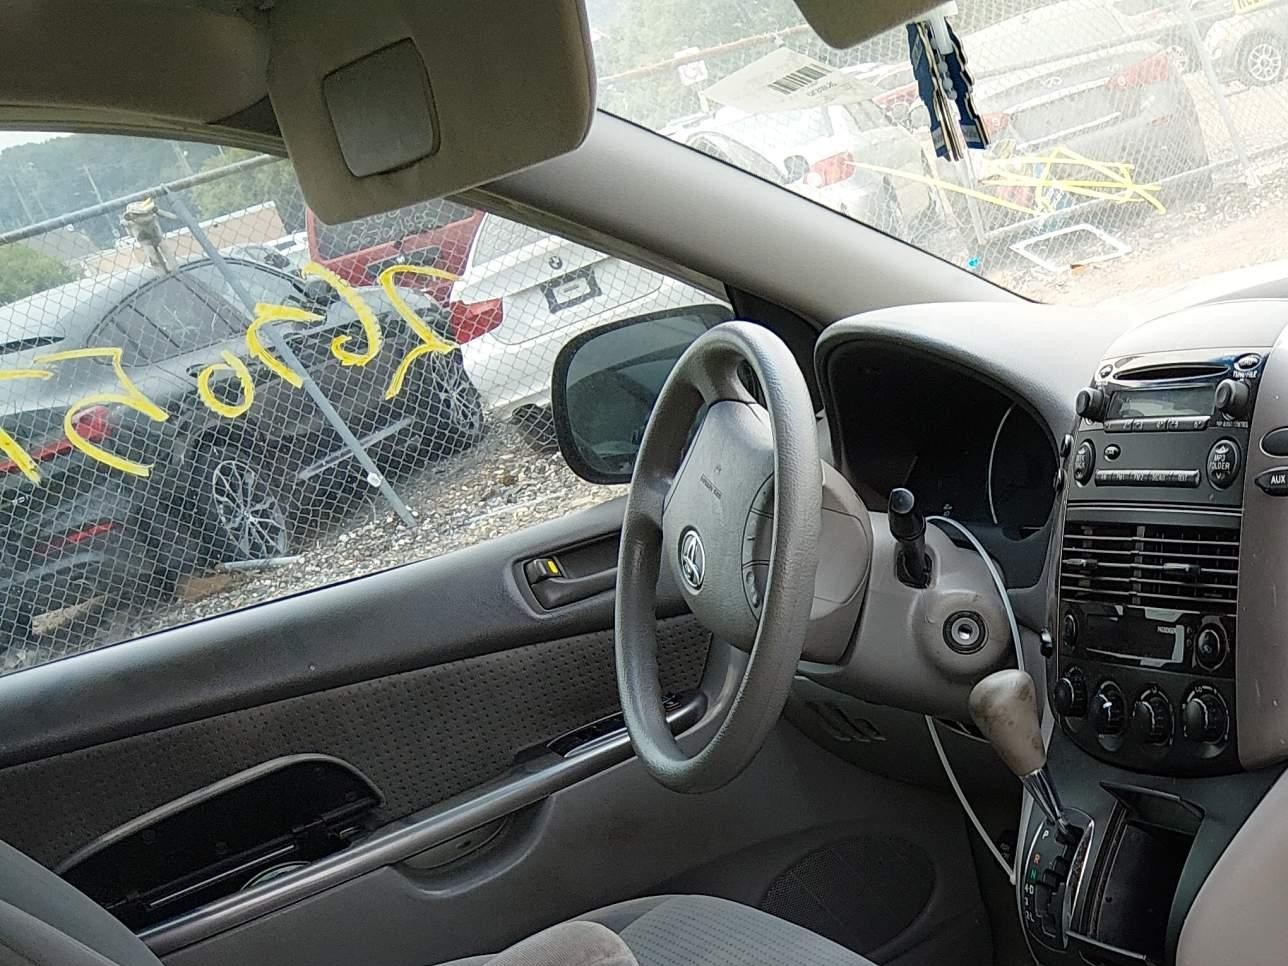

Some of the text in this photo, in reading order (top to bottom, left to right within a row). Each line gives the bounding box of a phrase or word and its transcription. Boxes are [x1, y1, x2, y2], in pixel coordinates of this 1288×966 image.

[1270, 474, 1286, 484] AUX
[1042, 830, 1050, 840] P
[1031, 868, 1037, 880] N
